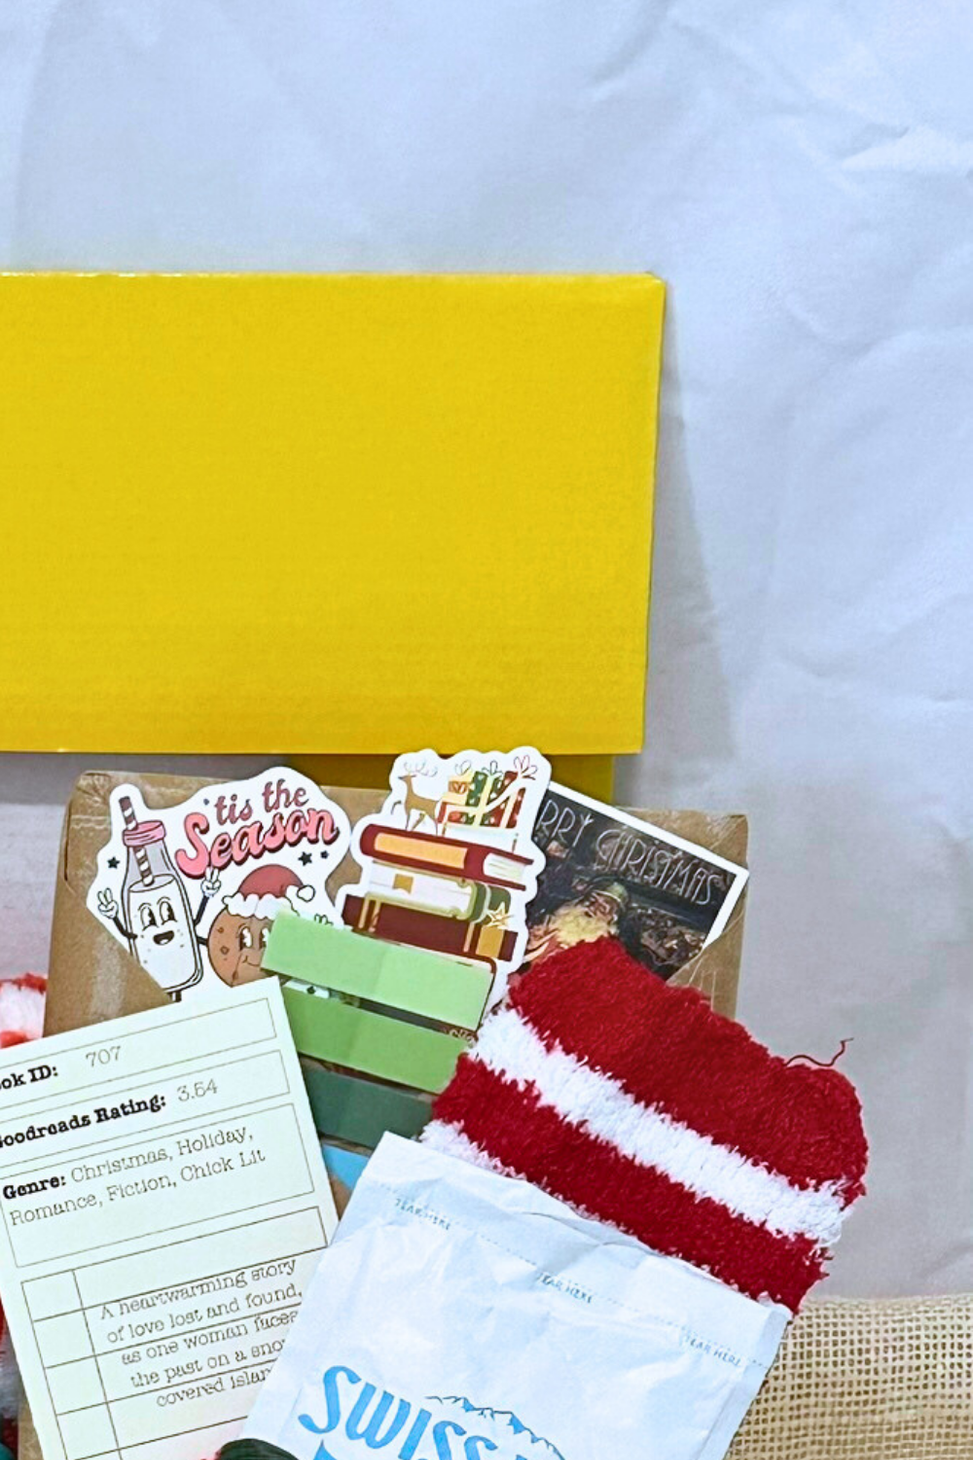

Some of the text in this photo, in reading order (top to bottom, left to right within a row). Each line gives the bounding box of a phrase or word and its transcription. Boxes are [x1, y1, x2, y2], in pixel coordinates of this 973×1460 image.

[261, 778, 310, 813] the
[174, 808, 340, 879] Season
[27, 1064, 59, 1083] ID:
[85, 1045, 122, 1069] 707
[93, 1094, 167, 1124] Rating:
[176, 1078, 219, 1103] 3.54
[2, 1125, 255, 1201] Genre: Christmas, Holiday,
[9, 1148, 266, 1227] Romance, Fiction, Chick Lit
[100, 1259, 296, 1320] A heartwarming story
[107, 1283, 303, 1344] of love lost and found,
[121, 1349, 142, 1366] as
[146, 1342, 179, 1358] one
[183, 1322, 249, 1350] woman
[130, 1338, 287, 1388] the past on a sno
[156, 1378, 225, 1408] covered
